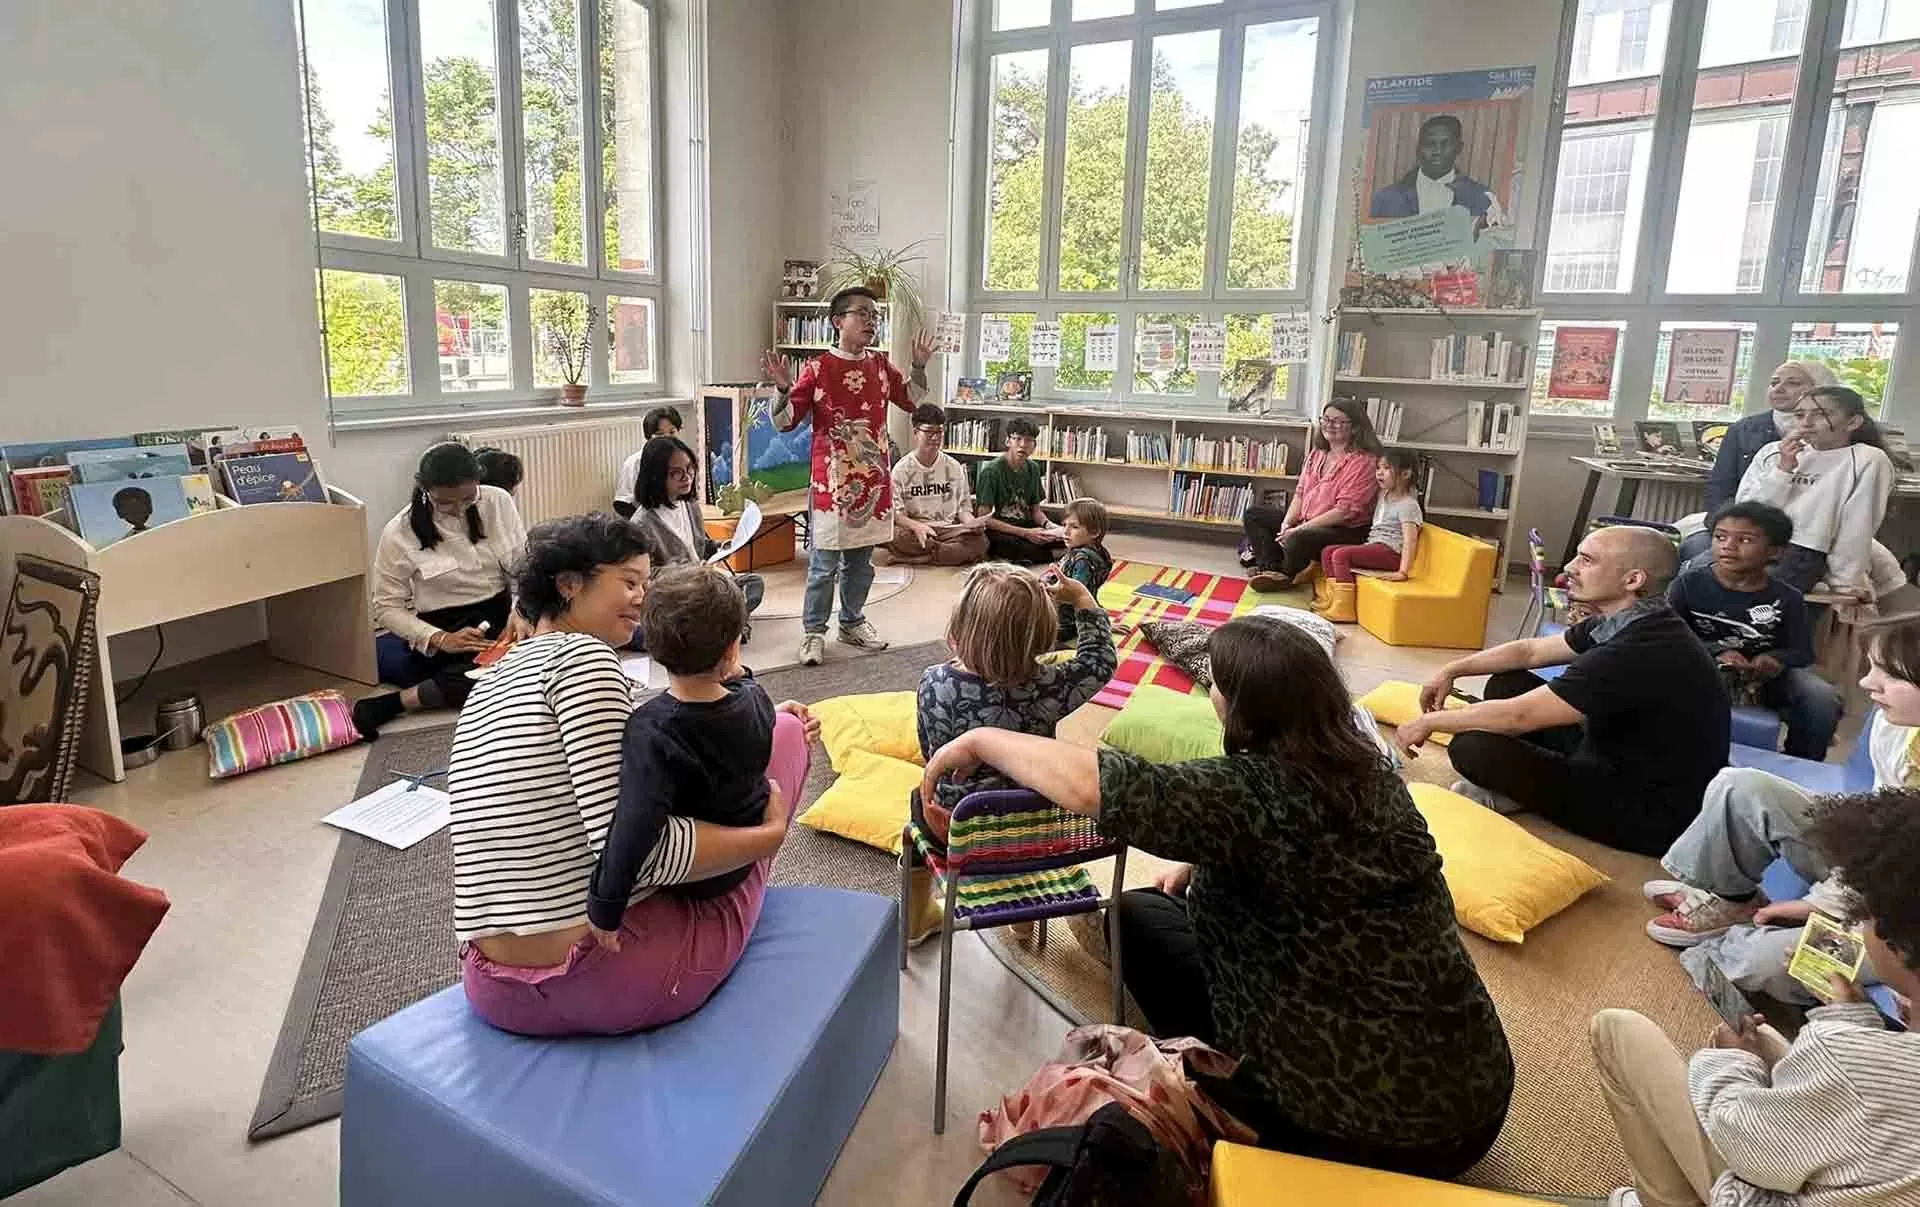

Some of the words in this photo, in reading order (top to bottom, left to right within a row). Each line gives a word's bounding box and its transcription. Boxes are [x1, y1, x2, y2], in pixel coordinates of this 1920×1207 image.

[1368, 77, 1433, 90] ATLANTIDE
[231, 464, 261, 475] Peau
[236, 473, 277, 487] d'épice
